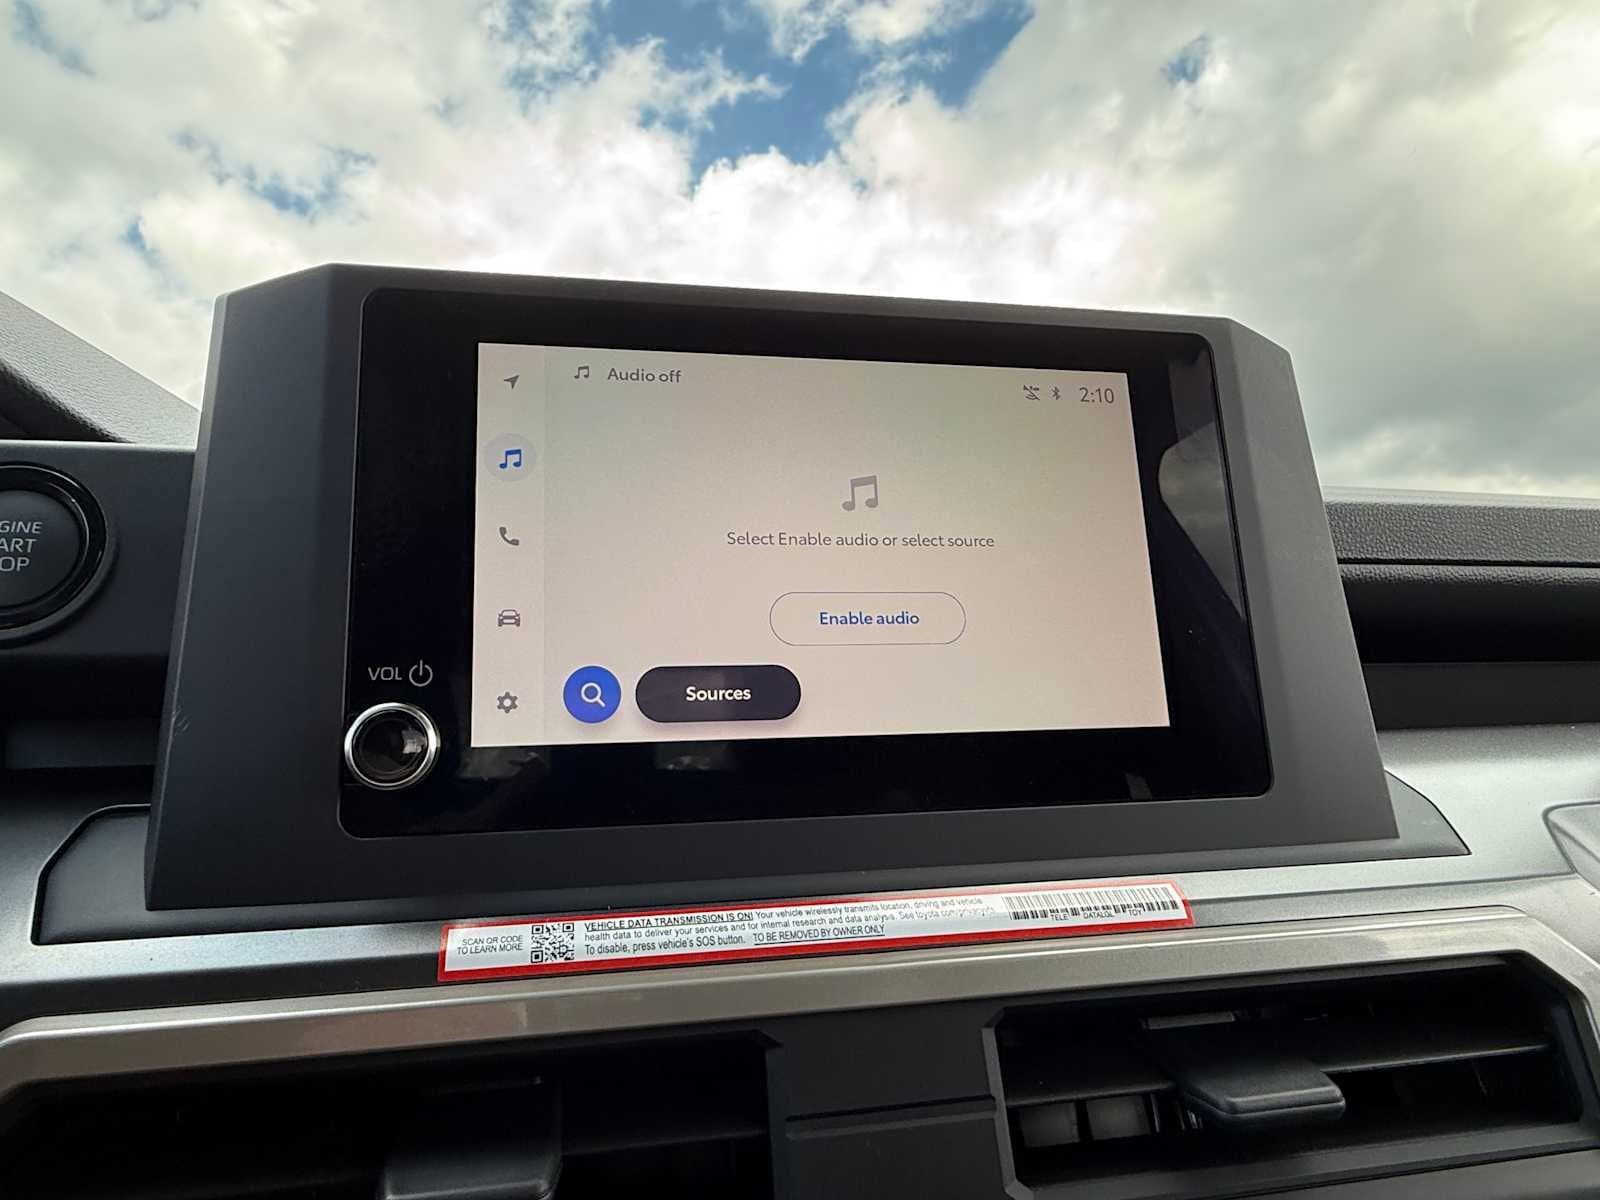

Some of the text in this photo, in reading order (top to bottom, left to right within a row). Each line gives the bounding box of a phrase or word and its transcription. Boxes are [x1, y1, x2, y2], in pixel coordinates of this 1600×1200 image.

[607, 367, 682, 383] Audio off
[1079, 387, 1114, 404] 2:10
[0, 520, 43, 534] GINE
[727, 532, 995, 547] Select Enable audio or select source
[819, 611, 920, 625] Enable audio
[367, 666, 402, 681] VOL
[685, 686, 752, 701] Sources
[584, 919, 626, 931] VEHICLE
[627, 918, 652, 928] DATA
[654, 913, 724, 926] TRANSMISSION
[726, 912, 735, 921] IS
[756, 910, 773, 919] Your
[775, 908, 803, 918] vehicle
[806, 906, 841, 916] wirelessly
[1050, 913, 1069, 921] TELE
[1128, 909, 1143, 917] TOY
[584, 931, 611, 942] health
[612, 930, 632, 940] data
[634, 929, 643, 938] to
[645, 927, 672, 938] deliver
[675, 928, 692, 938] your
[695, 923, 729, 934] services
[730, 922, 746, 931] and
[748, 921, 759, 930] for
[760, 919, 790, 929] internal
[792, 917, 827, 927] research
[828, 915, 844, 924] and
[845, 914, 863, 923] data
[462, 937, 485, 946] SCAN
[500, 934, 524, 943] CODE
[584, 924, 885, 956] To disable, press vehicle's SOS button. TO BE REMOVED BY OWNER ONLY
[457, 942, 524, 955] TO LEARN MORE
